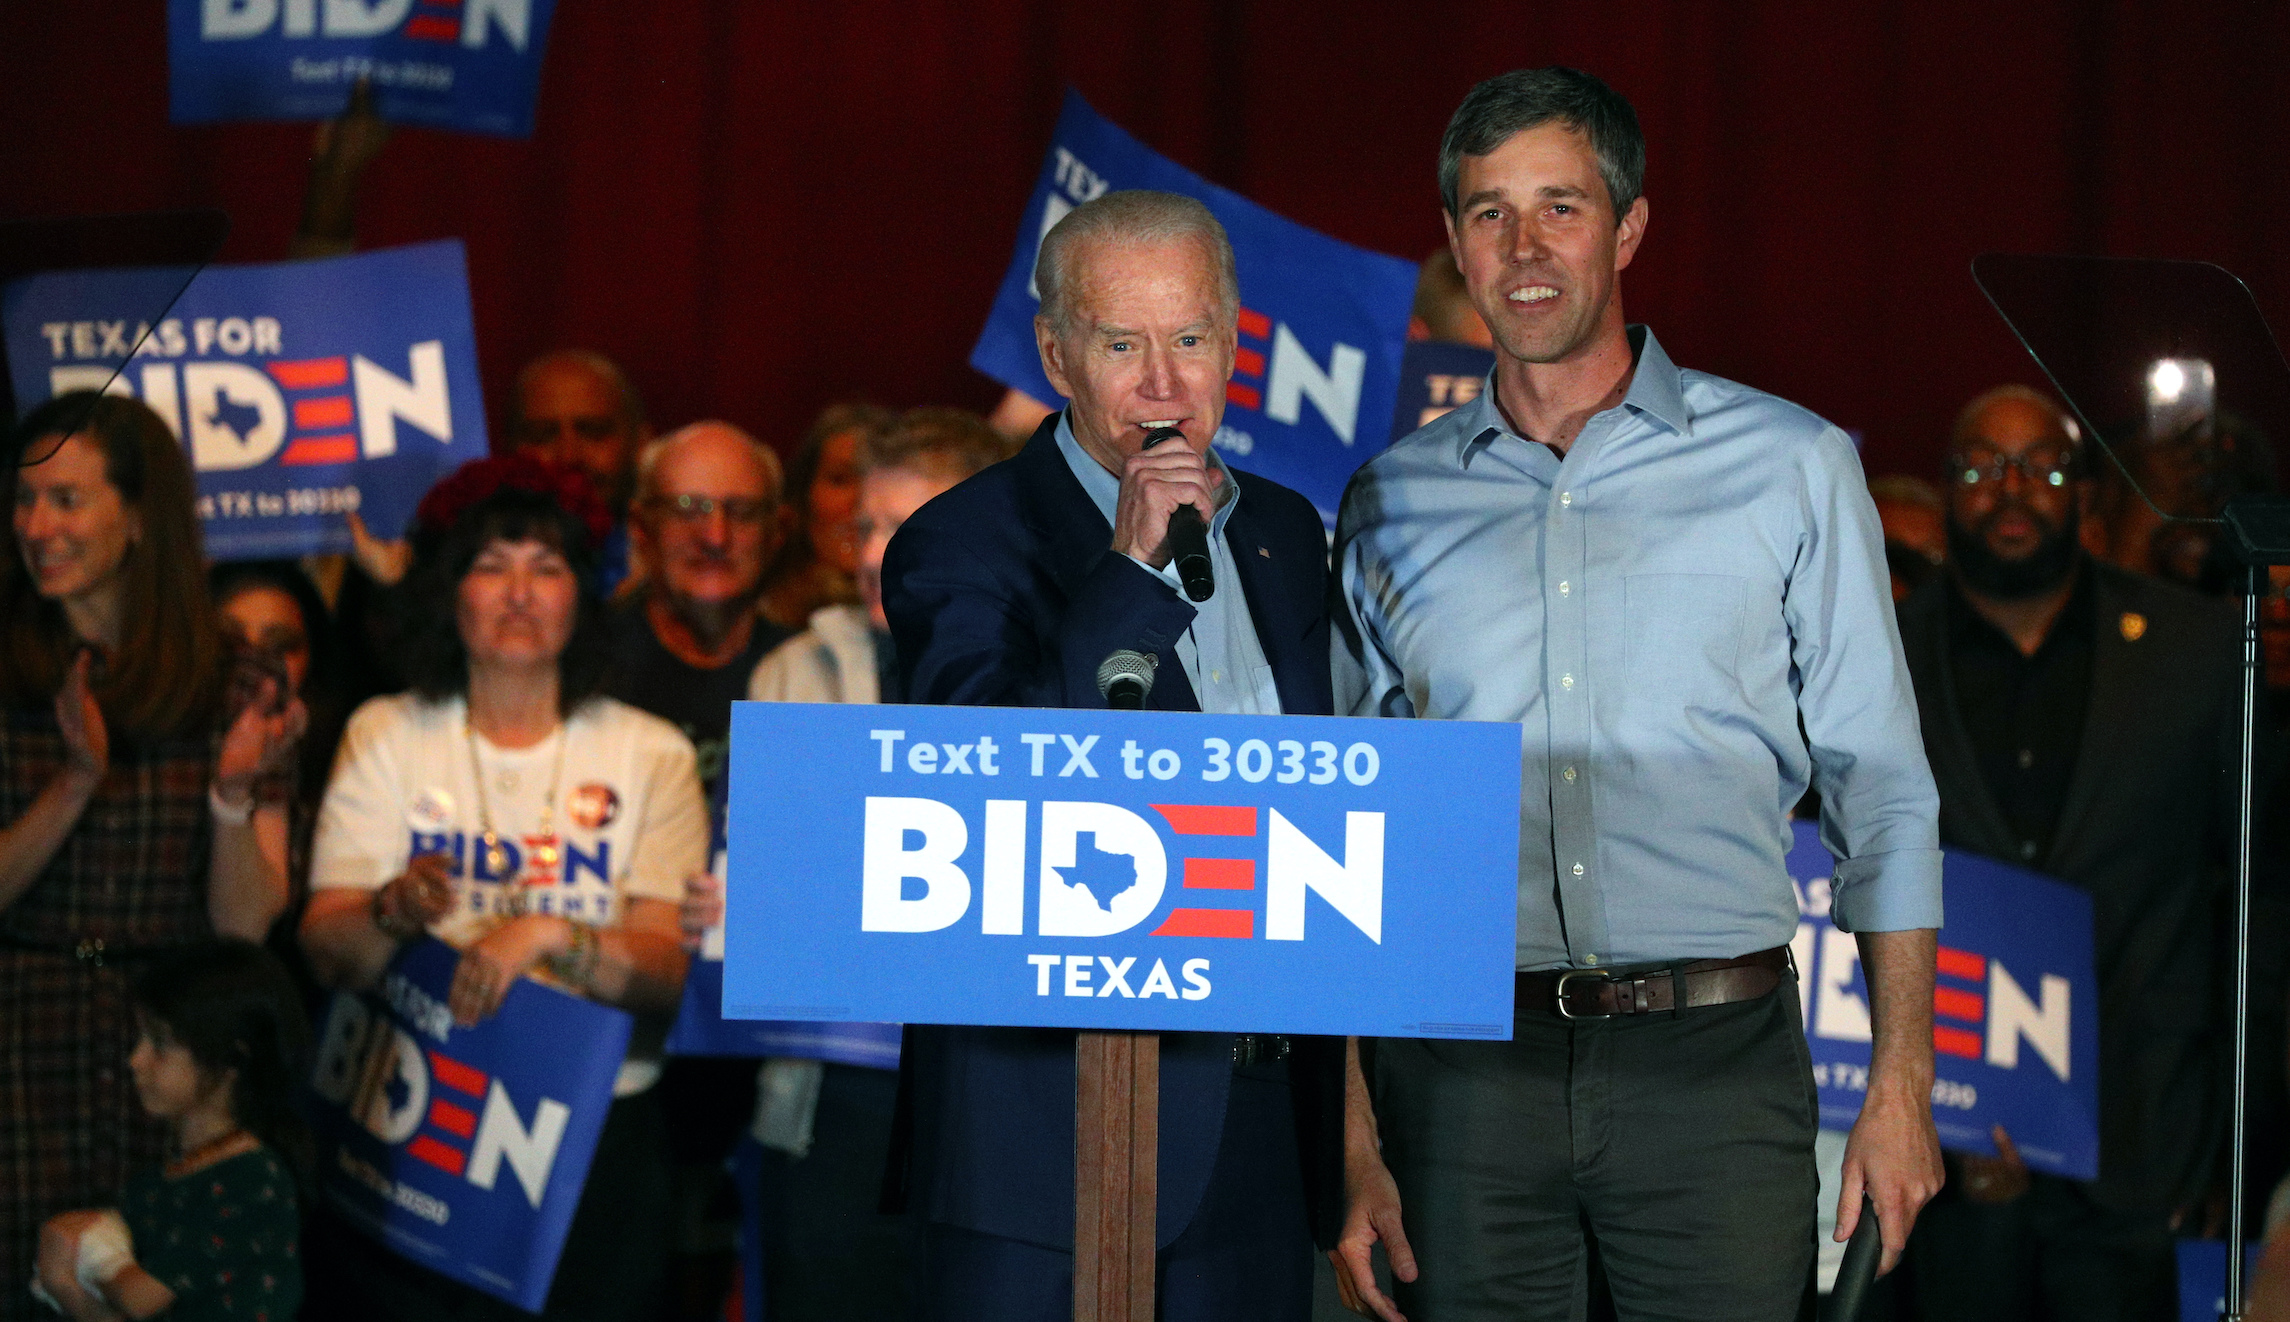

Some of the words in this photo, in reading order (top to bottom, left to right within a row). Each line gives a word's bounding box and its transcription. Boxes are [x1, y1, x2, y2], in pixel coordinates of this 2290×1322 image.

[1055, 147, 1109, 203] TEX
[43, 318, 187, 358] TEXAS
[193, 316, 282, 355] FOR
[50, 340, 453, 472] IDEN
[871, 730, 999, 775] Text
[1021, 734, 1099, 777] TX
[1121, 740, 1180, 780] to
[1203, 738, 1379, 786] 30330
[862, 796, 1385, 945] BIDEN
[1028, 954, 1211, 1000] TEXAS
[312, 993, 571, 1210] BIDEN
